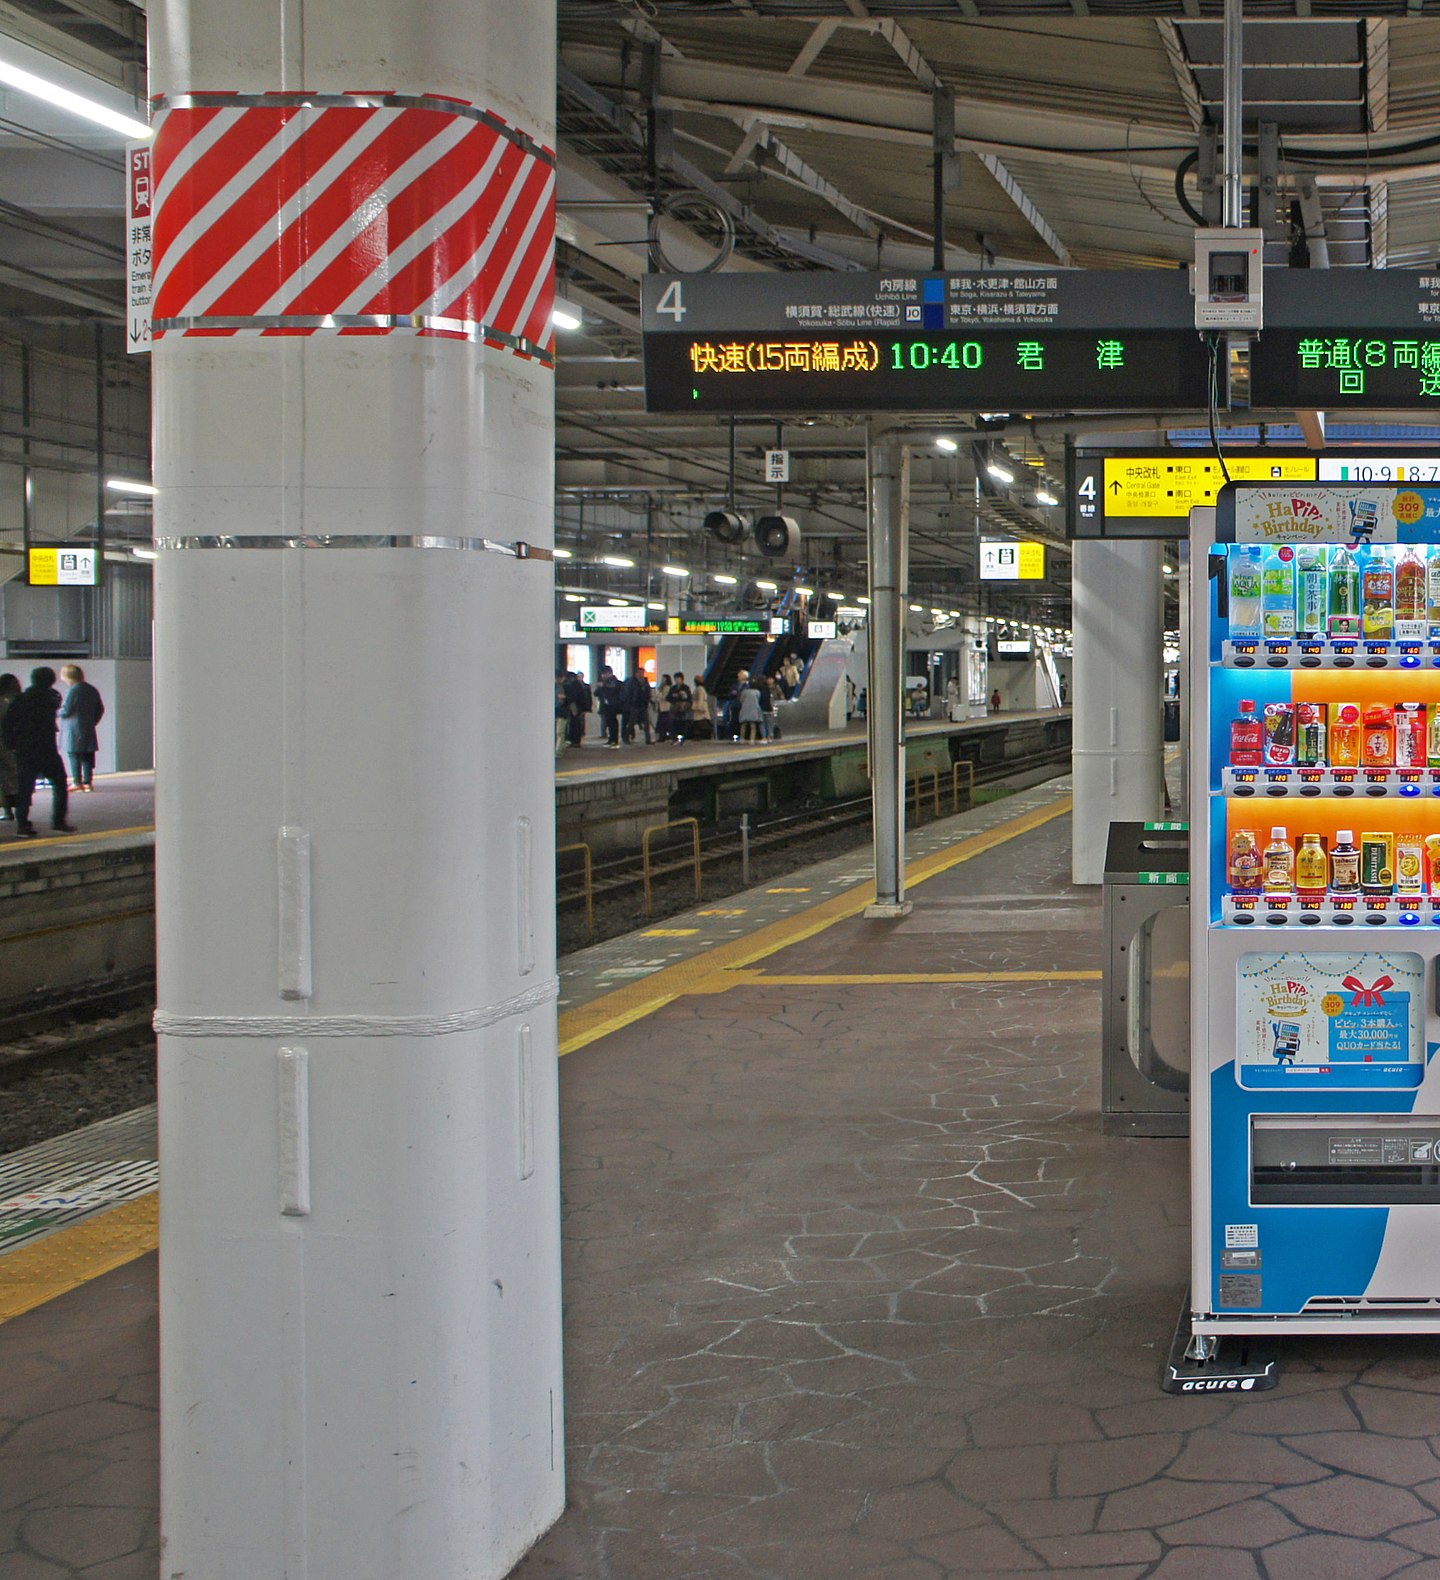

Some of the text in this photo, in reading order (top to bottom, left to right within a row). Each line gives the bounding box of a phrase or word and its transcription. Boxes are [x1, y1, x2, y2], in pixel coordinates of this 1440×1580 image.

[131, 282, 147, 294] train
[879, 279, 918, 292] 内房線
[949, 278, 1058, 290] 蘇我・木更津・館山方面
[901, 293, 918, 301] Line
[950, 291, 959, 299] for
[980, 291, 1007, 299] Kisarazu
[1008, 291, 1014, 299] &
[1015, 291, 1047, 300] Tateyama
[1430, 290, 1440, 298] for
[656, 280, 687, 323] 4
[907, 306, 920, 320] JO
[949, 303, 1059, 316] 東京・横浜・横須賀方面
[856, 318, 873, 327] Line
[873, 318, 901, 328] (Rapid)
[981, 316, 1015, 324] Yokohama
[1015, 316, 1022, 324] &
[1022, 316, 1054, 324] Yokosuka
[1423, 315, 1433, 323] for
[690, 341, 880, 373] 快速(15両編成)
[891, 342, 982, 370] 10:40
[769, 452, 785, 479] 指示
[1175, 466, 1192, 474] 東口
[1284, 466, 1310, 474] モノレール
[1126, 467, 1161, 480] 中央改札
[1078, 476, 1096, 500] 4
[1126, 481, 1161, 489] Central Gate
[1175, 489, 1192, 498] 南口
[1397, 502, 1420, 512] 309
[1260, 517, 1324, 539] Birthday
[1275, 533, 1309, 541] キャンペーン
[1370, 847, 1378, 883] DEMITASSE
[1265, 994, 1309, 1009] Birthday
[1182, 1379, 1238, 1391] acure
